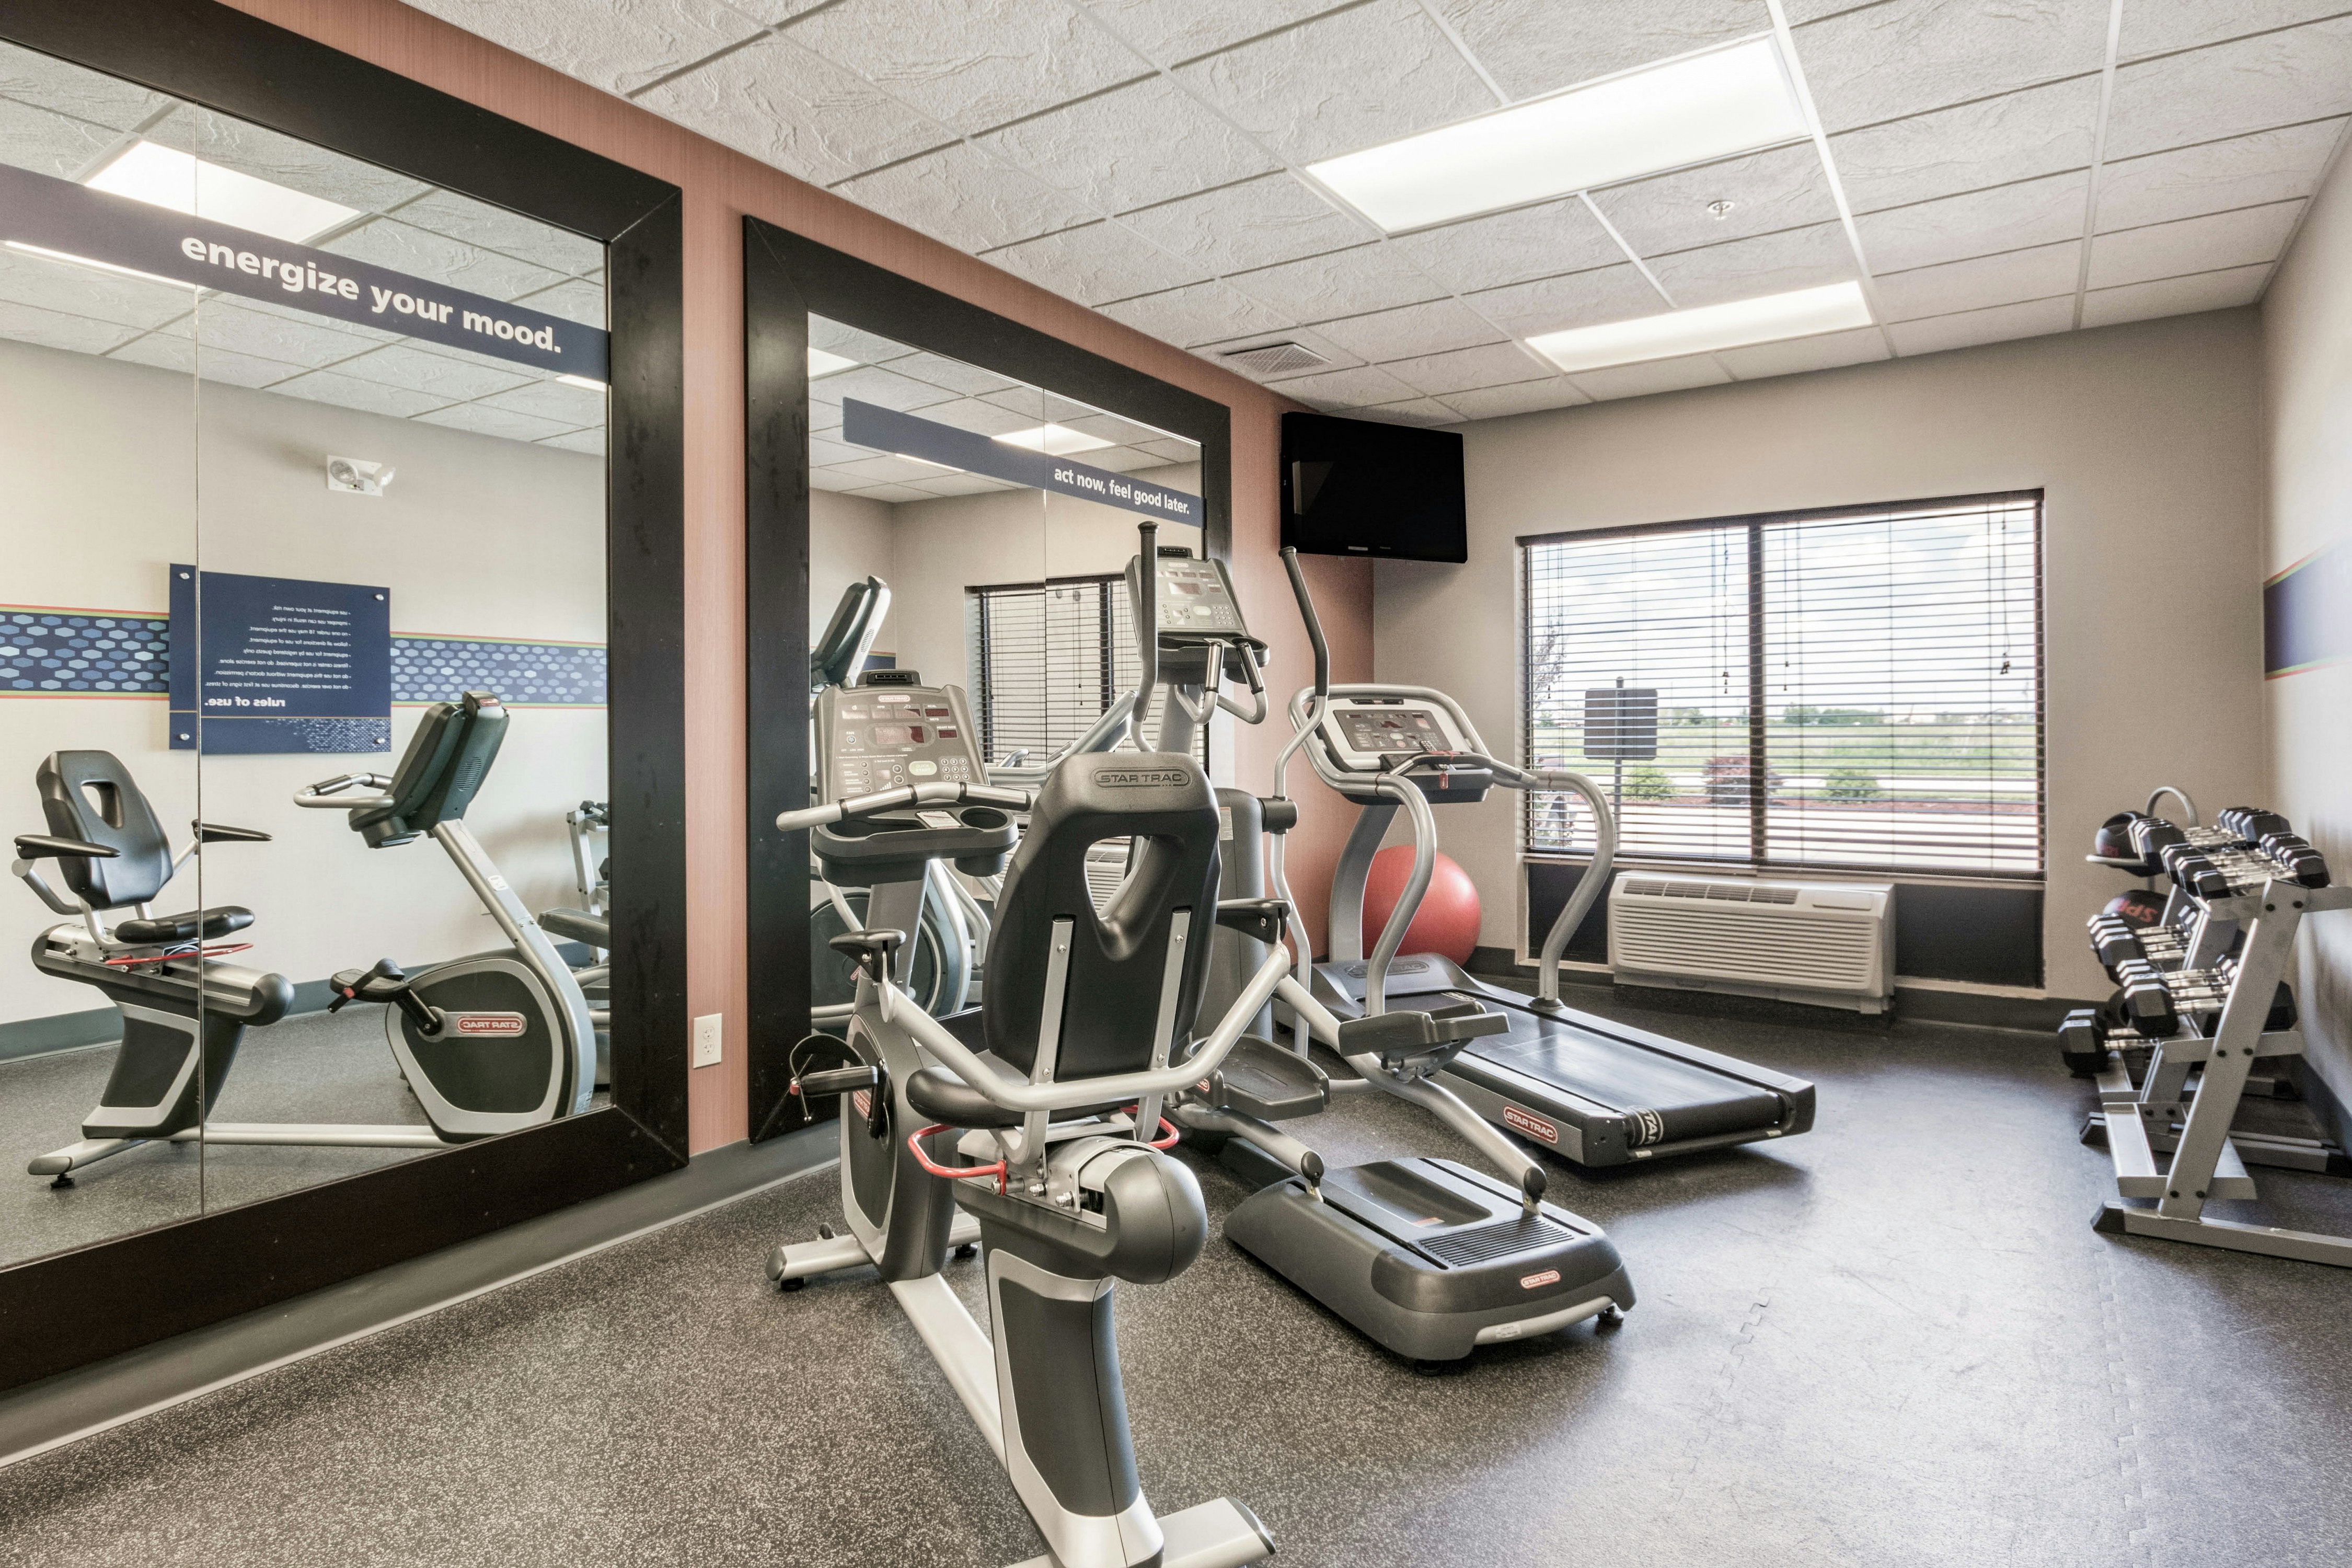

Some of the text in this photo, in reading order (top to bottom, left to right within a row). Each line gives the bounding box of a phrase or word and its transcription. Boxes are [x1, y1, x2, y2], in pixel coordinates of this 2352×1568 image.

[181, 237, 561, 353] energize your mood.
[1054, 468, 1190, 514] act now, feel good later.
[1098, 774, 1182, 783] STAR TRAC
[1506, 1112, 1554, 1138] STAR TRAC
[1524, 1277, 1540, 1286] STAR
